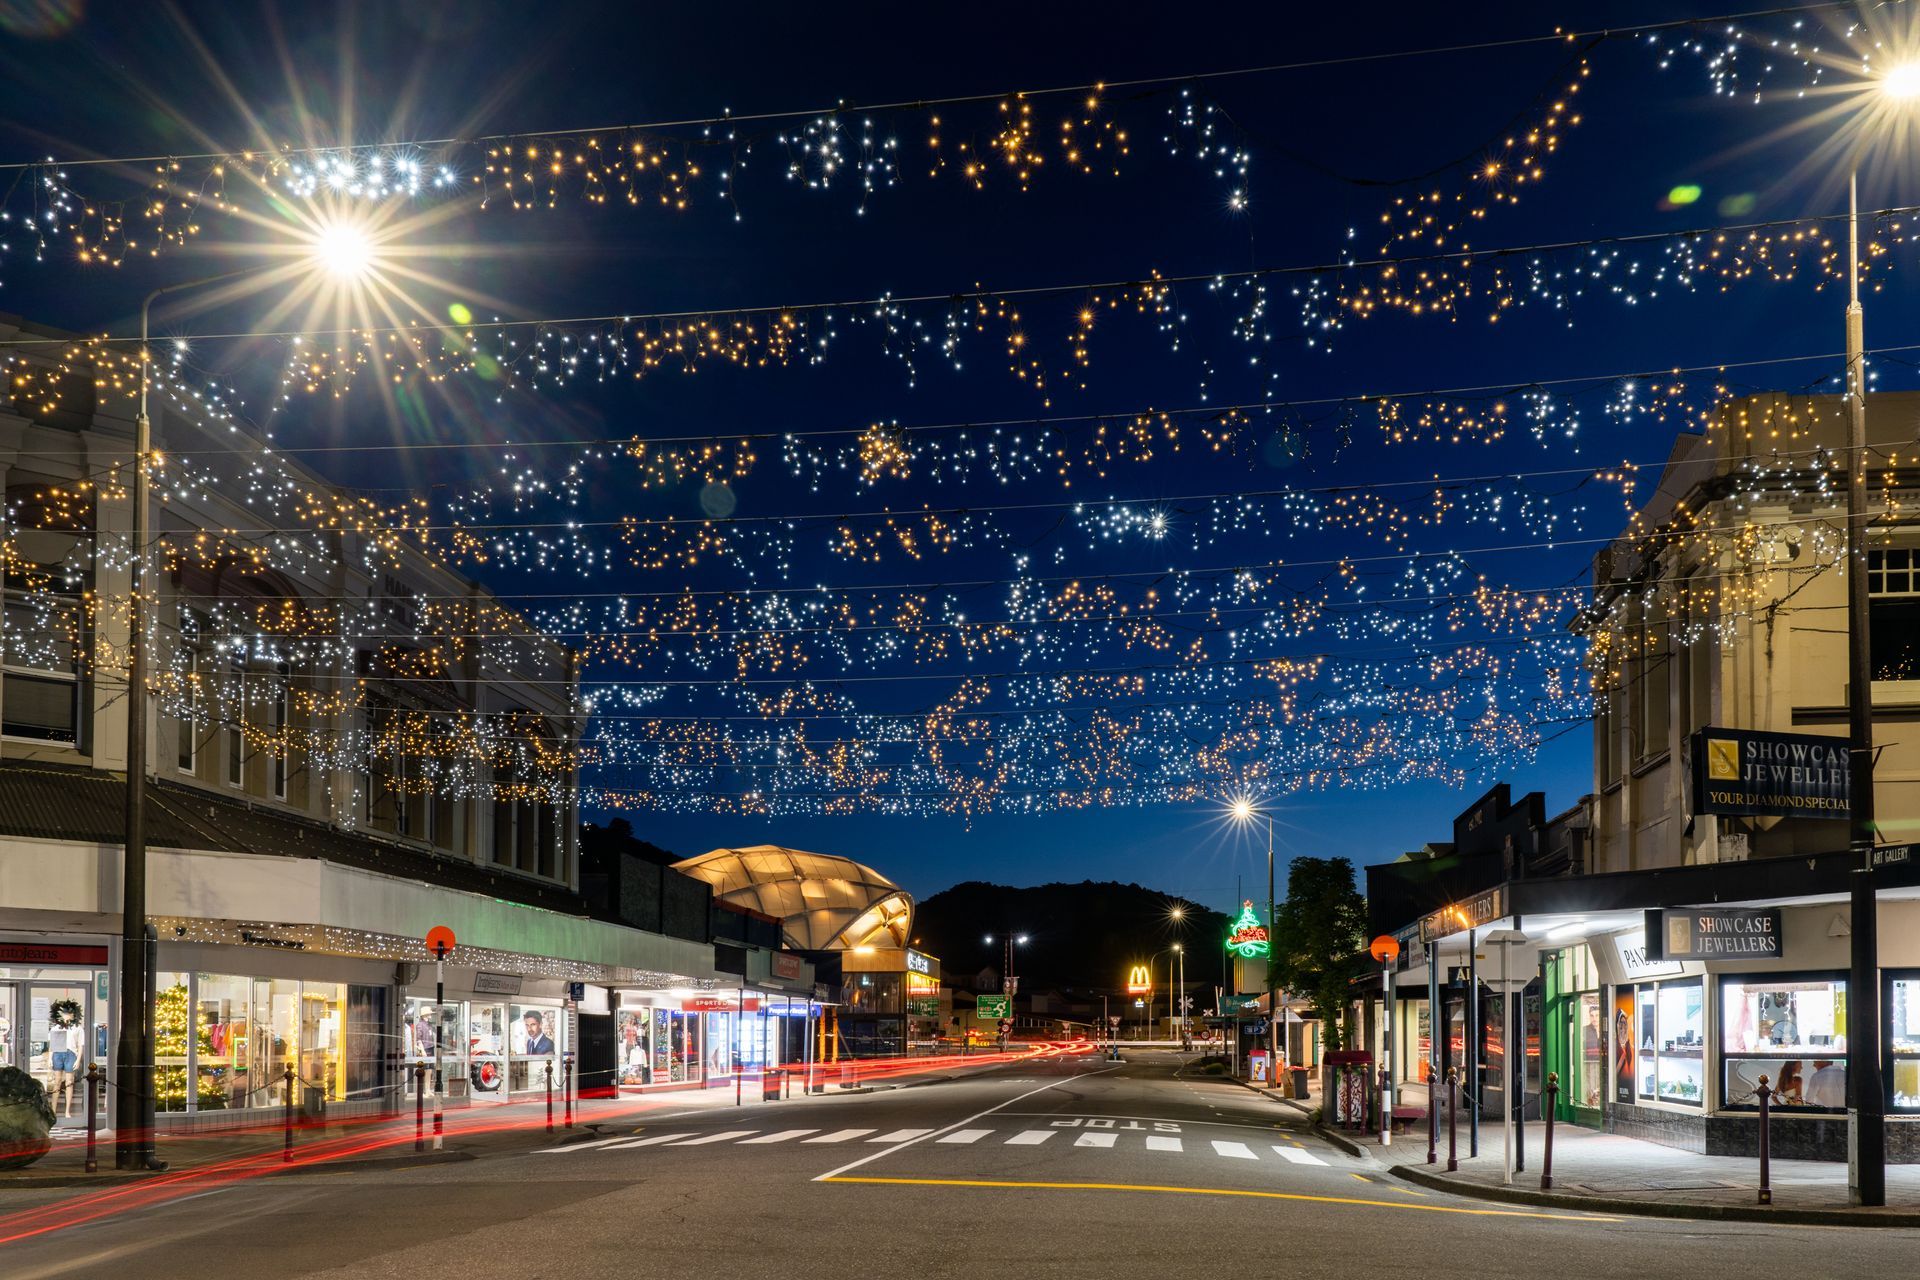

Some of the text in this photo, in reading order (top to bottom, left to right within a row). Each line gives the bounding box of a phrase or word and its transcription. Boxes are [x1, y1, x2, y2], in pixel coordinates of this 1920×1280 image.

[1746, 740, 1850, 764] SHOWCAS
[1709, 791, 1851, 810] YOUR DIAMOND SPECIAL
[1873, 846, 1909, 865] ART GALLERY
[1698, 916, 1772, 934] SHOWCASE
[1696, 936, 1776, 953] JEWELLERS
[1050, 1118, 1182, 1133] STOP
